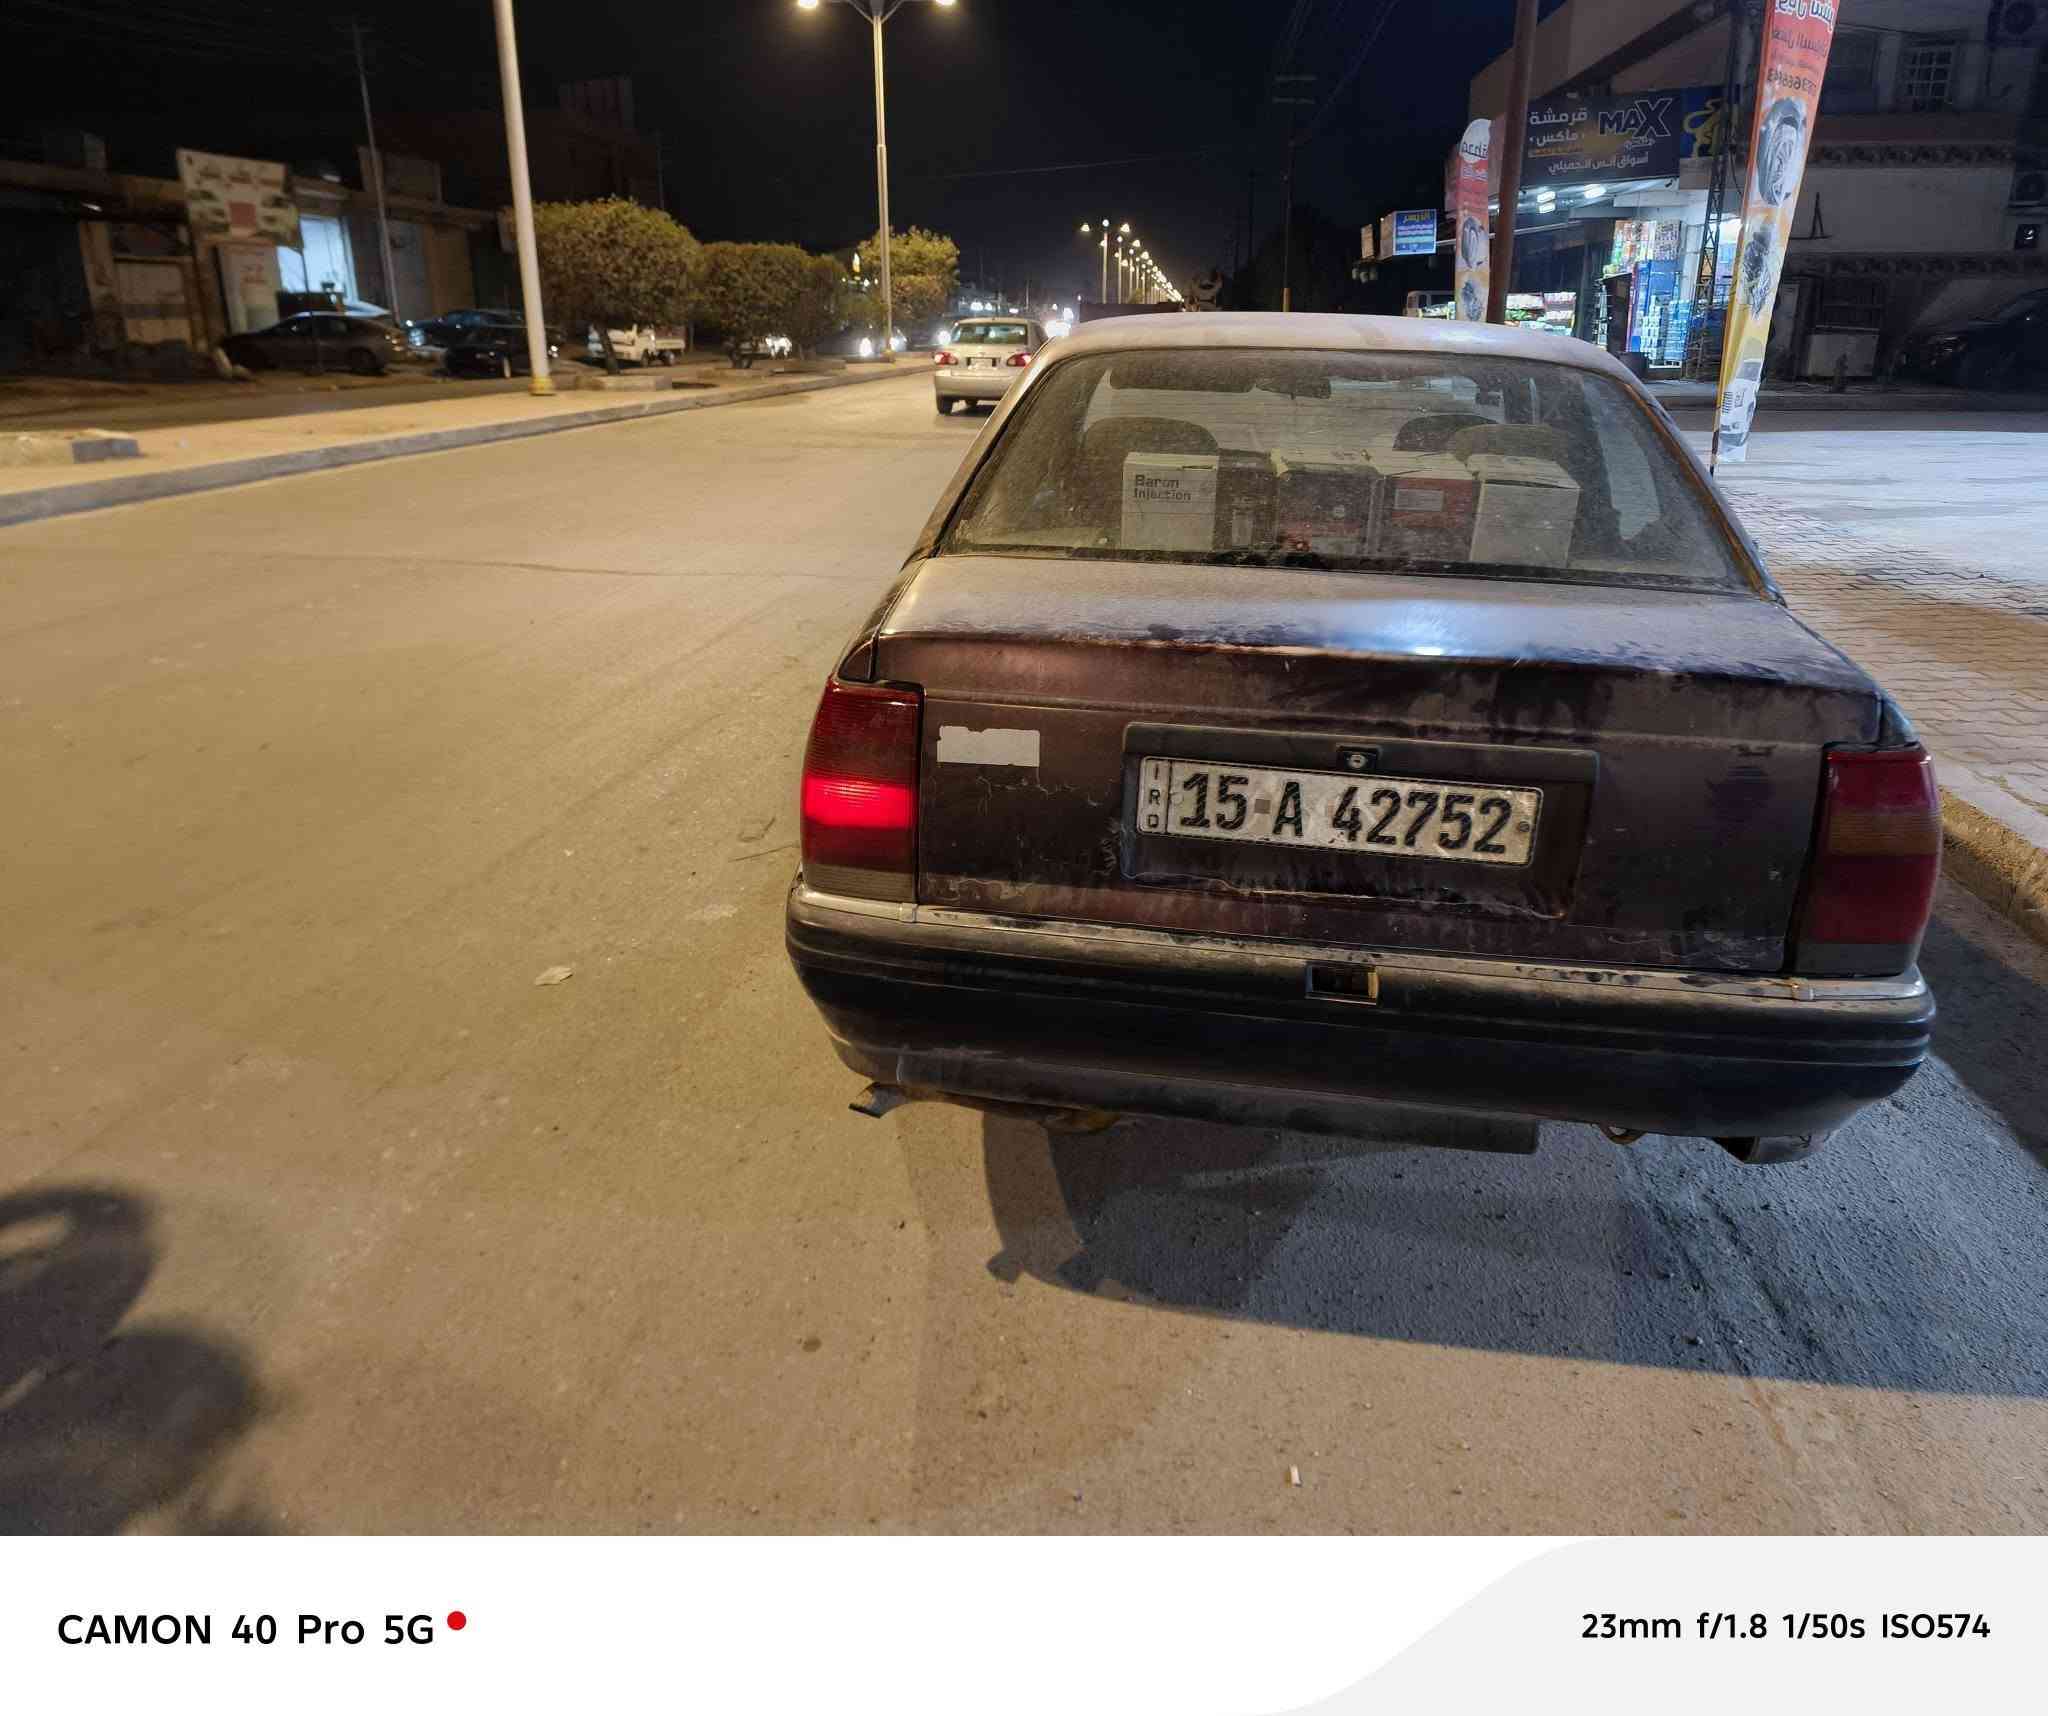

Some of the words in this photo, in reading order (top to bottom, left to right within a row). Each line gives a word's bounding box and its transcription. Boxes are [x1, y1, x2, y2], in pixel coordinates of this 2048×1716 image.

[1529, 107, 1588, 126] قرمشة
[1599, 98, 1672, 137] MAX
[1536, 129, 1578, 147] ماكس
[1135, 474, 1180, 488] Baron
[1180, 773, 1250, 830] 15
[1272, 781, 1304, 837] A
[1331, 785, 1514, 855] 42752
